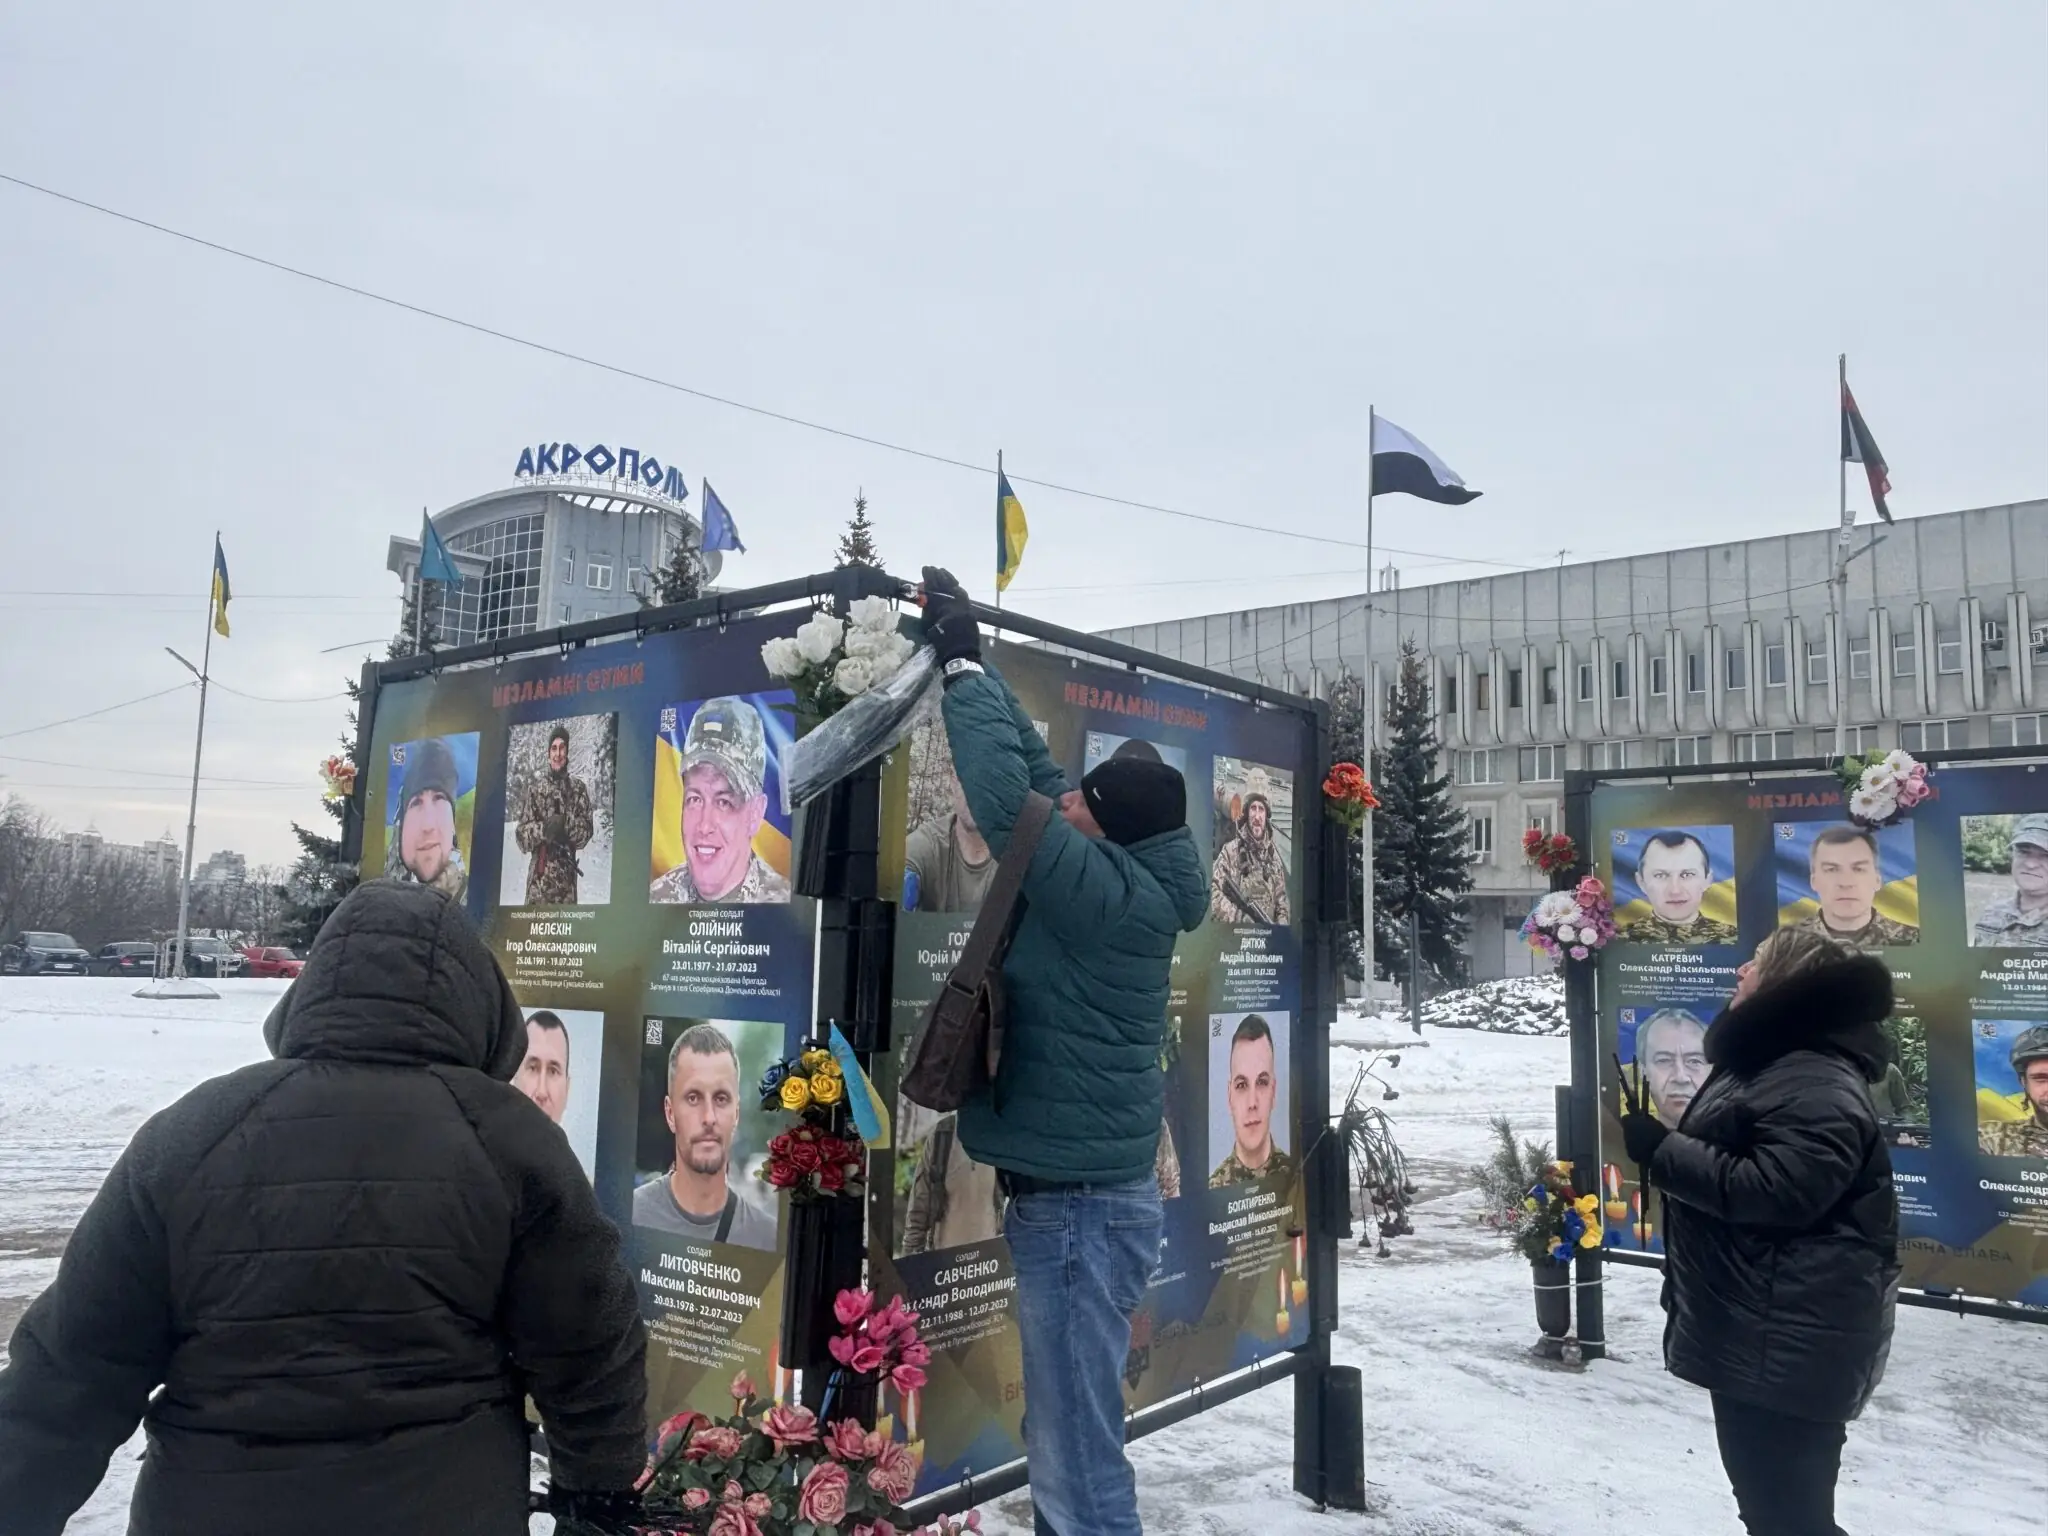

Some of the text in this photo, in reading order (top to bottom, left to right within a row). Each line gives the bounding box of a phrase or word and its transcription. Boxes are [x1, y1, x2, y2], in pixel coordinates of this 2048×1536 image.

[514, 442, 689, 501] АКРОПОЛЬ
[1064, 681, 1159, 721] НЕЗЛАМНІ
[1747, 791, 1839, 809] НЕЗЛАМ
[689, 920, 743, 936] ОЛІЙНИК
[506, 939, 597, 955] Ігор Олександрович
[948, 932, 970, 946] ГОЛ
[663, 940, 770, 958] Віталій Сергійович
[672, 961, 711, 970] 23.01.1977
[716, 962, 757, 972] 21.07.2023
[918, 949, 962, 967] Юрій М
[1651, 953, 1703, 963] КАТРЕВИЧ
[2003, 959, 2048, 970] ФЕДОР
[932, 972, 950, 981] 10.1
[1620, 963, 1736, 975] Олександр Васильович
[1980, 970, 2048, 982] Андрій Ми
[2021, 1170, 2048, 1182] БОР
[1228, 1192, 1276, 1214] БОГАТИРЕНКО
[686, 1245, 712, 1258] солдат
[955, 1250, 980, 1263] солдат
[659, 1253, 742, 1283] ЛИТОВЧЕНКО
[934, 1259, 999, 1286] САВЧЕНКО
[641, 1268, 761, 1309] Максим Васильович
[951, 1276, 1017, 1302] Володимир
[700, 1305, 743, 1323] 22.07.2023
[969, 1298, 1008, 1317] 12.07.2023
